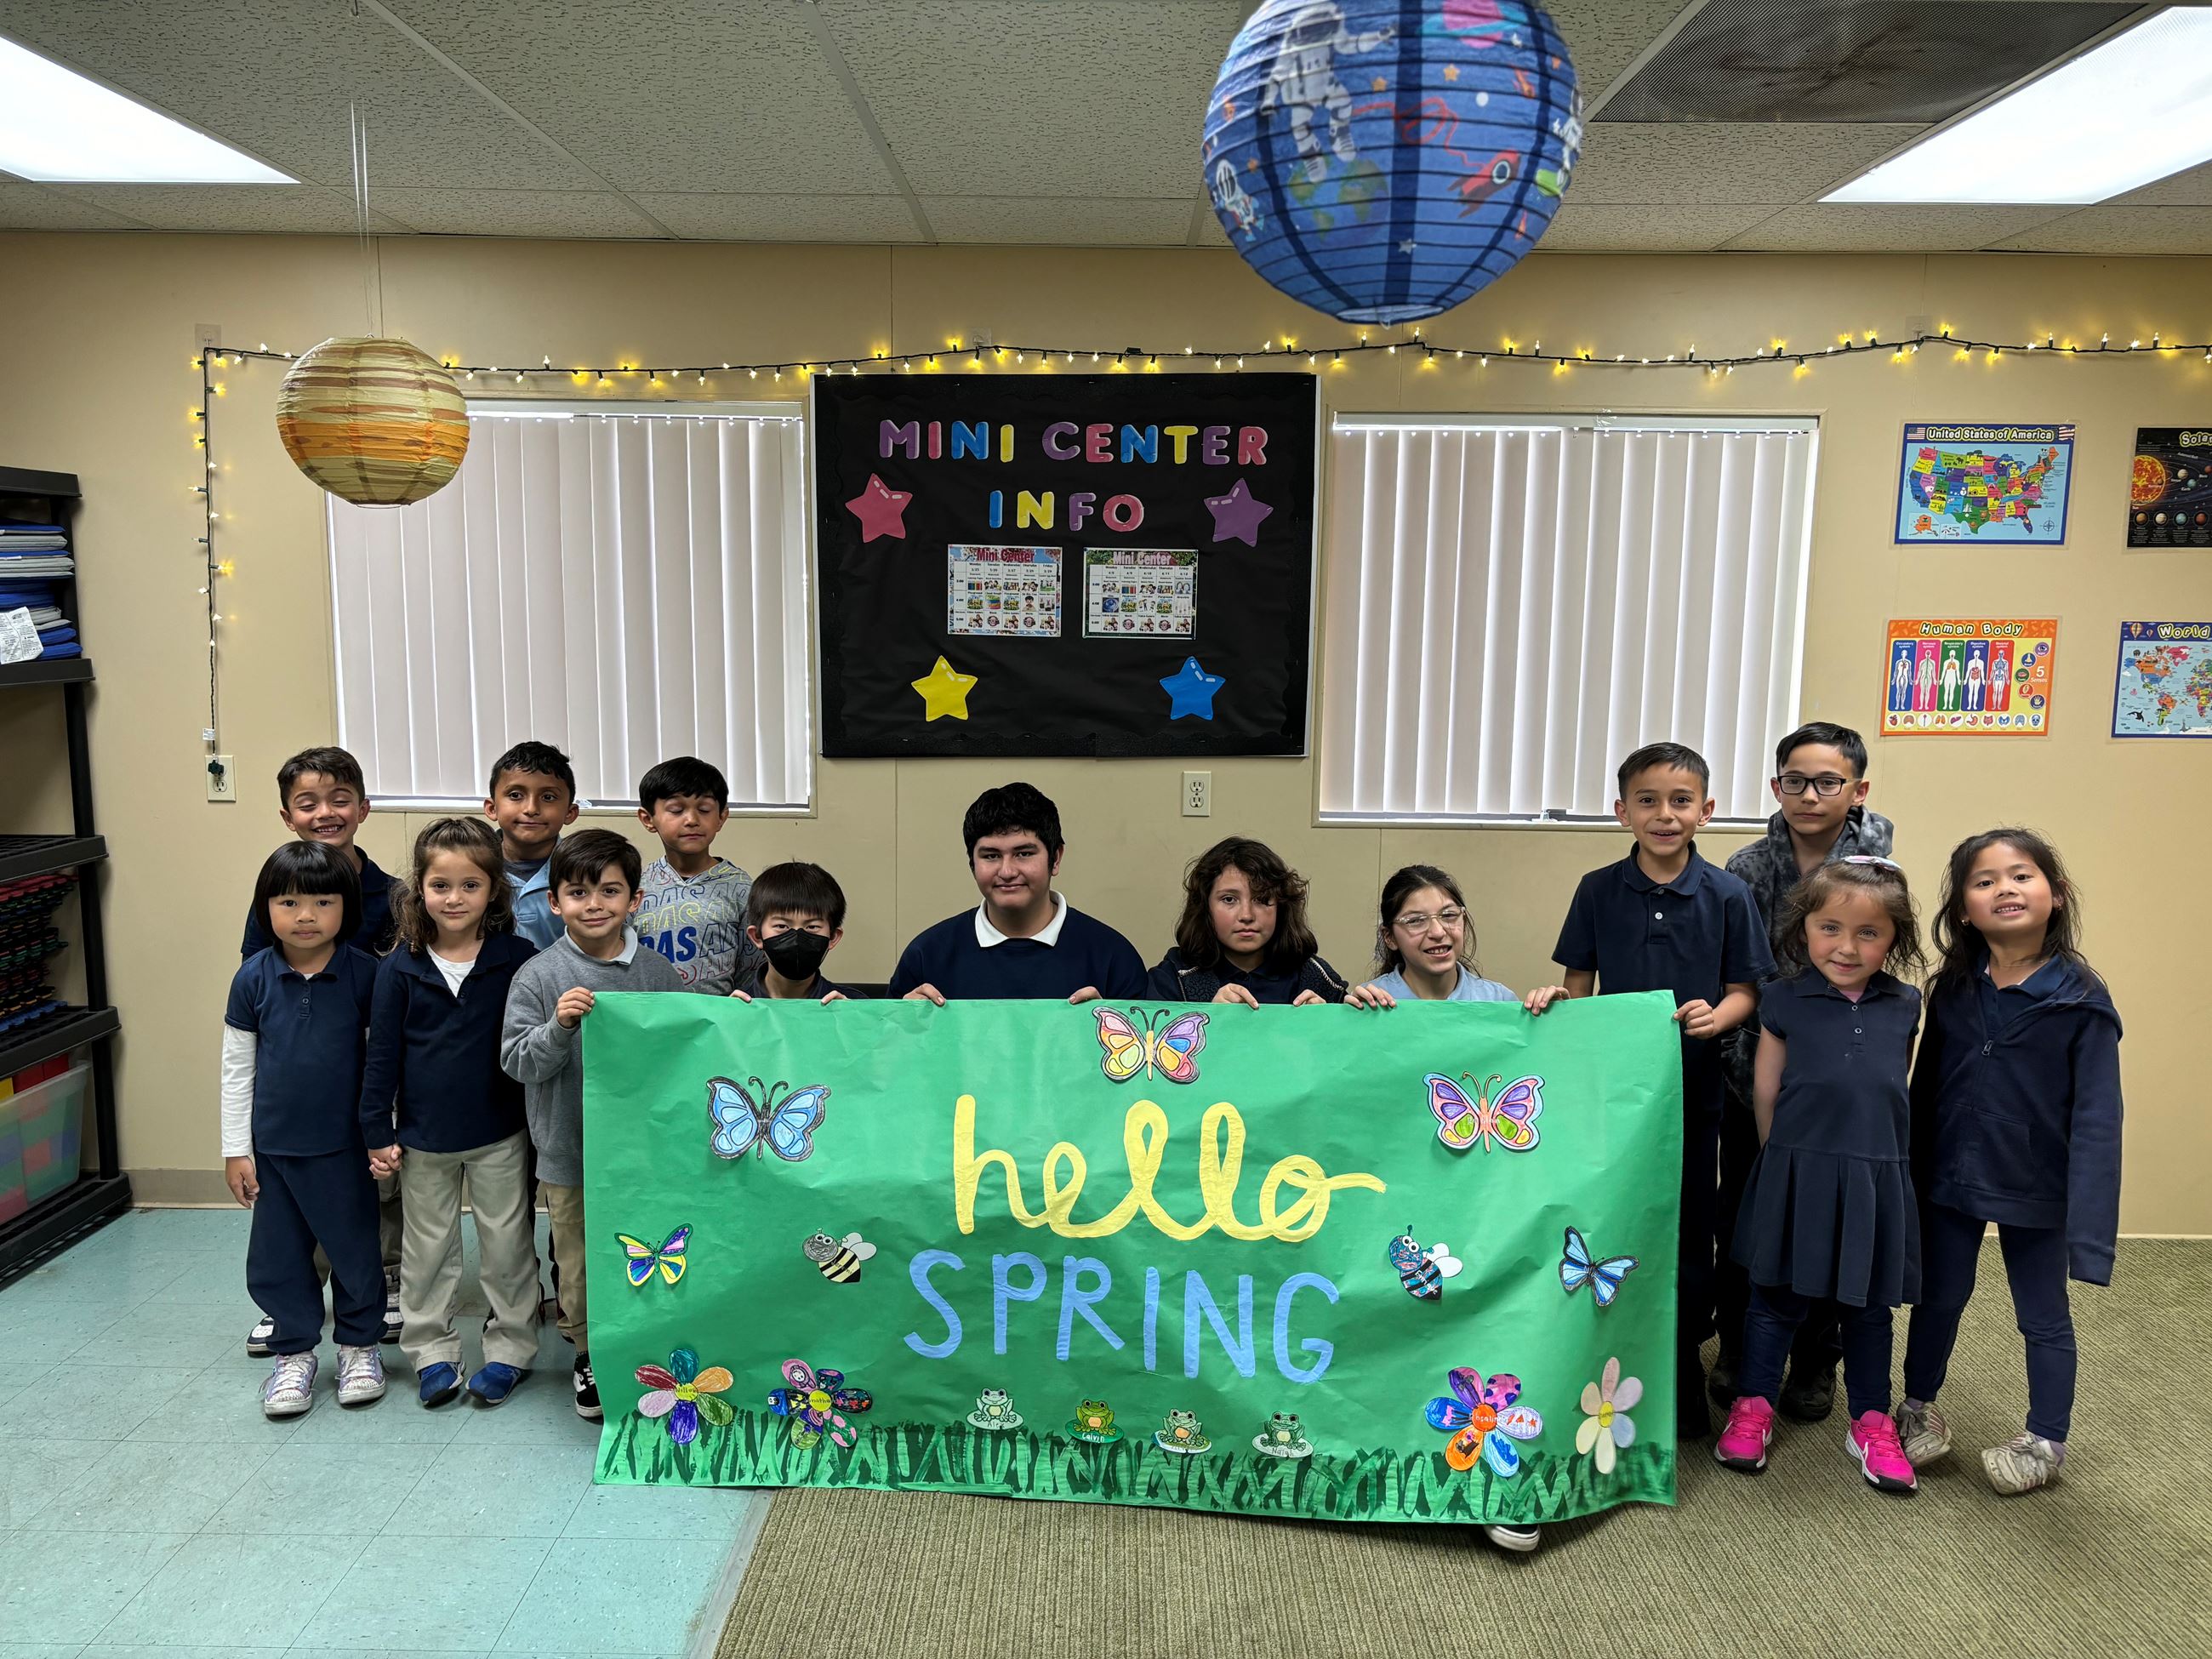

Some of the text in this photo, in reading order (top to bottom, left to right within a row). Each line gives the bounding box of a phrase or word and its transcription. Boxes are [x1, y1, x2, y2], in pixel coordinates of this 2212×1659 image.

[1927, 428, 2052, 440] United States of America
[879, 419, 1268, 465] MINI CENTER
[989, 490, 1145, 532] INFO
[977, 547, 1035, 562] Mini Center
[1113, 551, 1172, 566] Mini Center
[1920, 622, 2023, 636] Human Body
[2158, 625, 2209, 639] World
[2036, 665, 2045, 677] 5
[955, 1094, 1387, 1243] hello
[904, 1249, 1339, 1384] SPRING
[1081, 1432, 1105, 1444] Calvin
